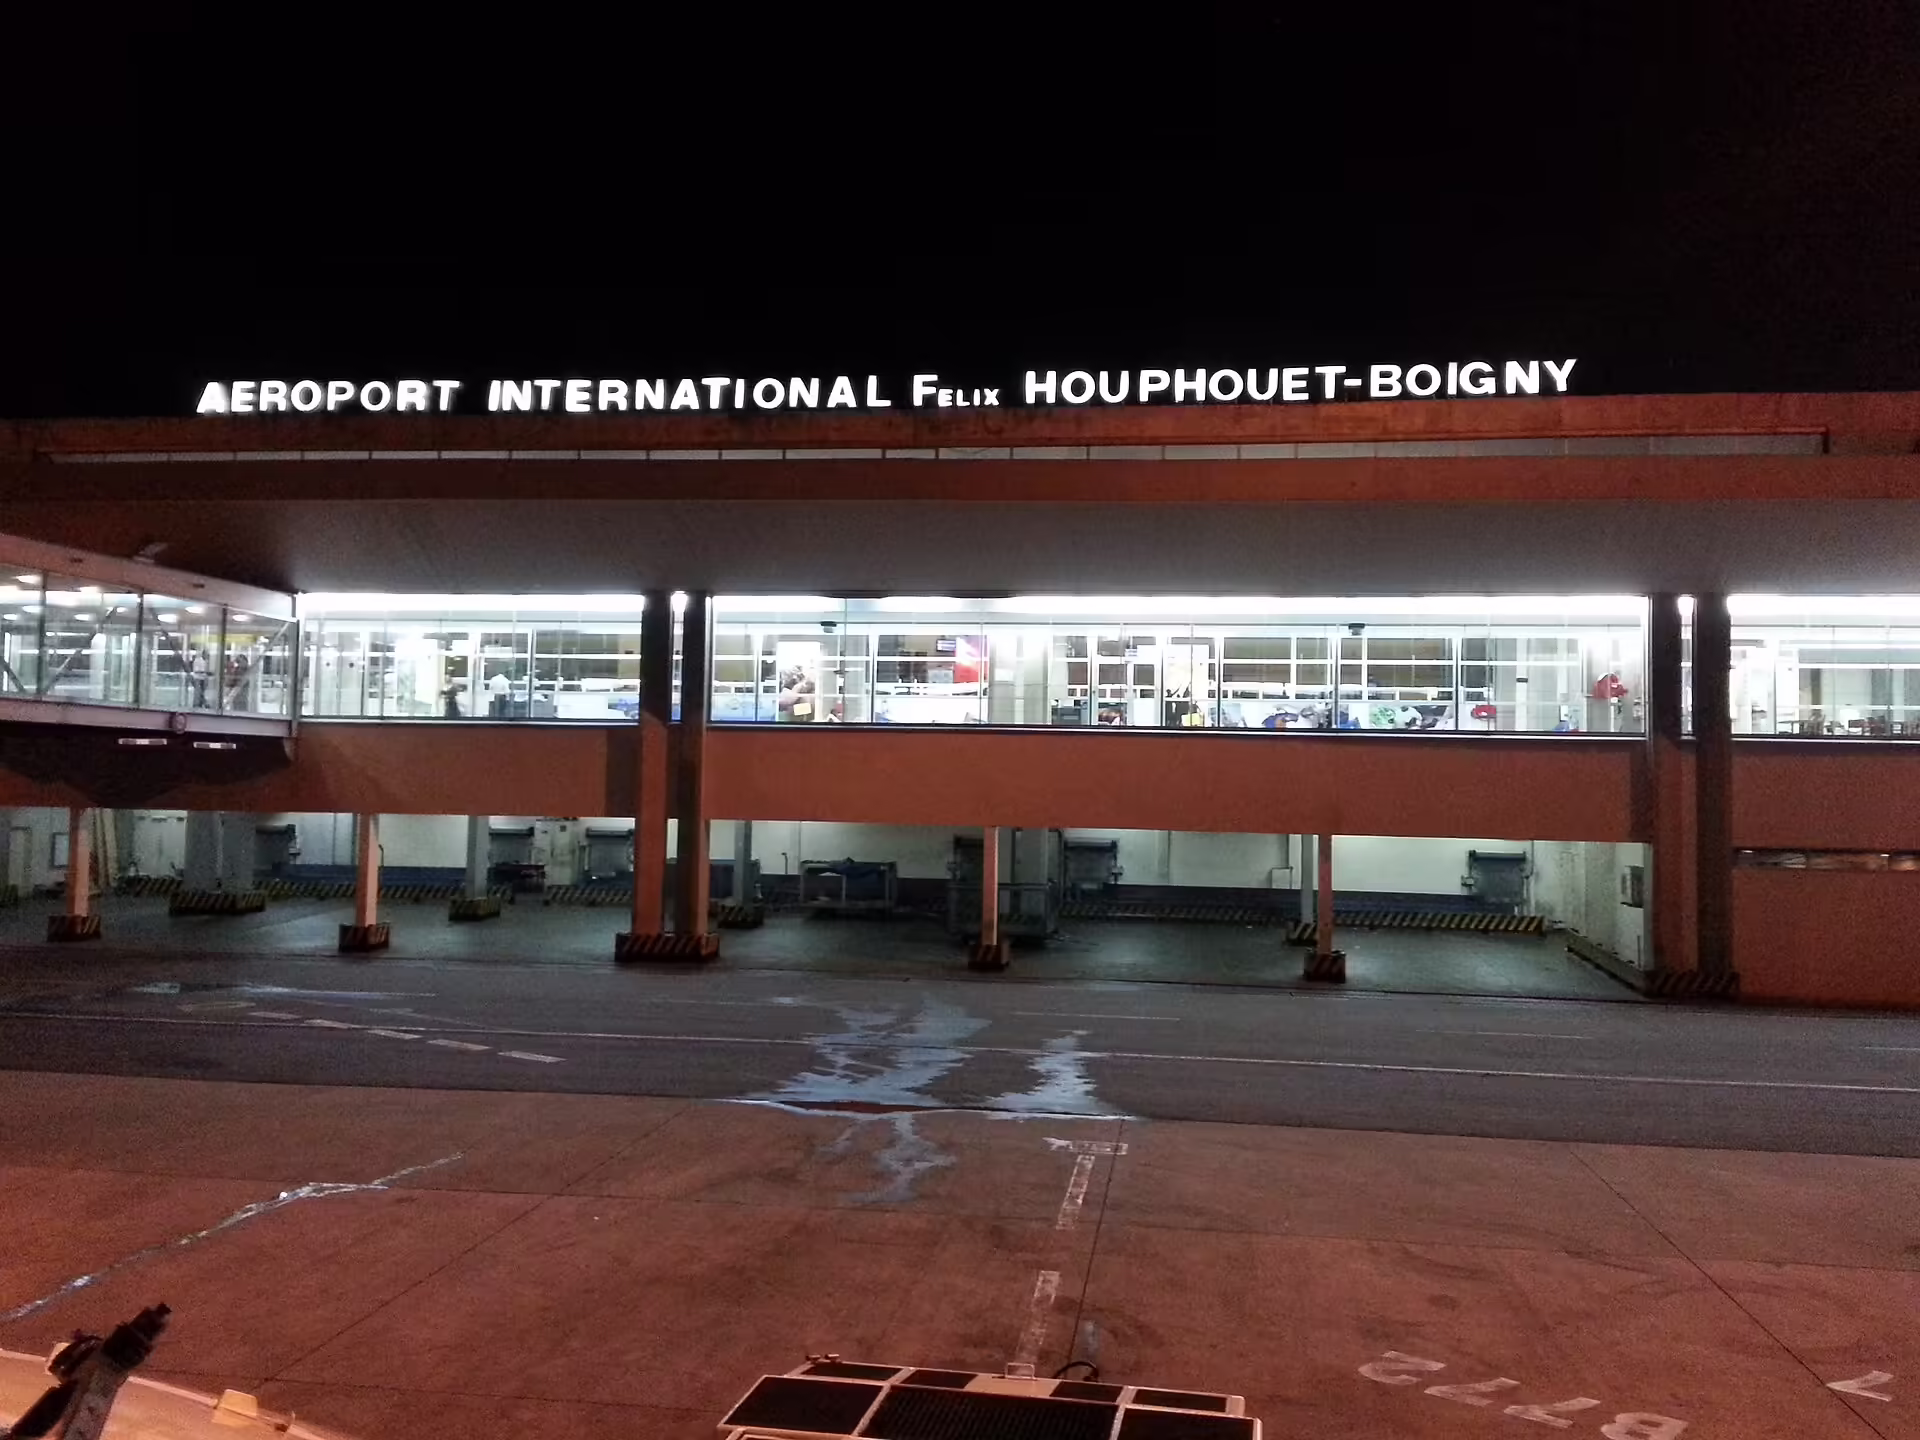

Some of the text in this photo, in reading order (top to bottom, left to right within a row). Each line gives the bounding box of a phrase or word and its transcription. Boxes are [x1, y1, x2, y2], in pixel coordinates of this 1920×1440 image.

[197, 380, 460, 413] AEROPORT
[488, 375, 891, 412] INTERNATIONAL
[1025, 359, 1576, 403] HOUPHOUET-BOIGNY
